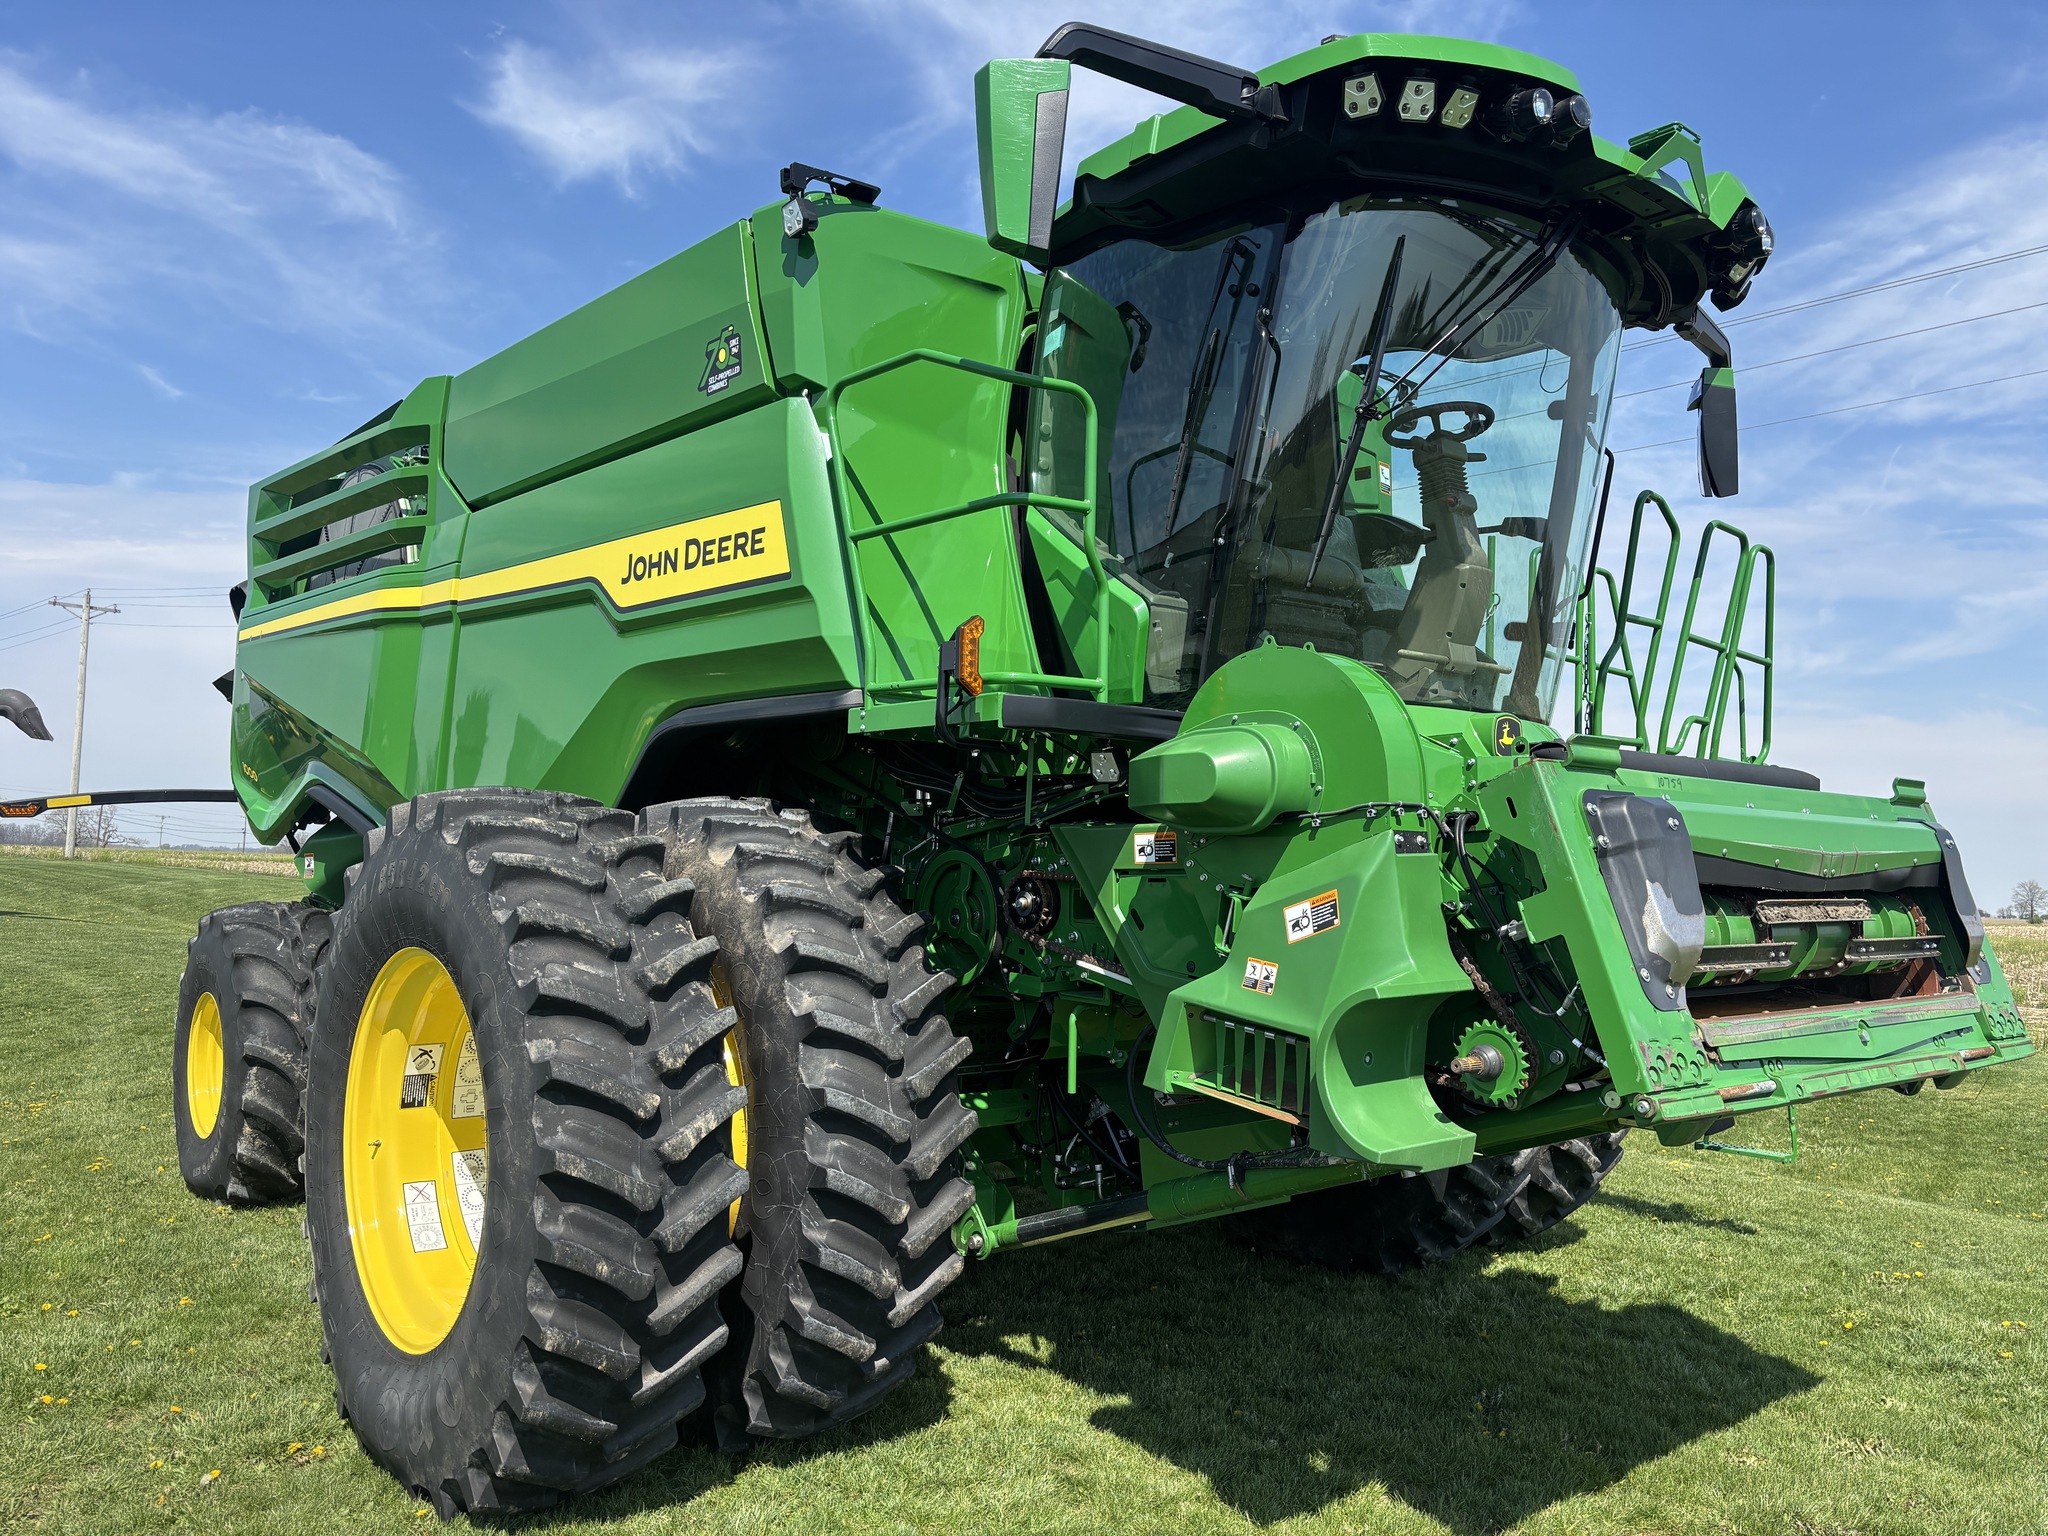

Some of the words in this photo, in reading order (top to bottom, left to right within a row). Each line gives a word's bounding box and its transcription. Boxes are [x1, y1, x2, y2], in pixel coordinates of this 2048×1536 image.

[729, 336, 739, 348] SINCE
[708, 365, 740, 385] SELF-PROPELLED
[707, 379, 728, 393] COMBINES
[621, 547, 678, 585] JOHN
[684, 526, 766, 571] DEERE
